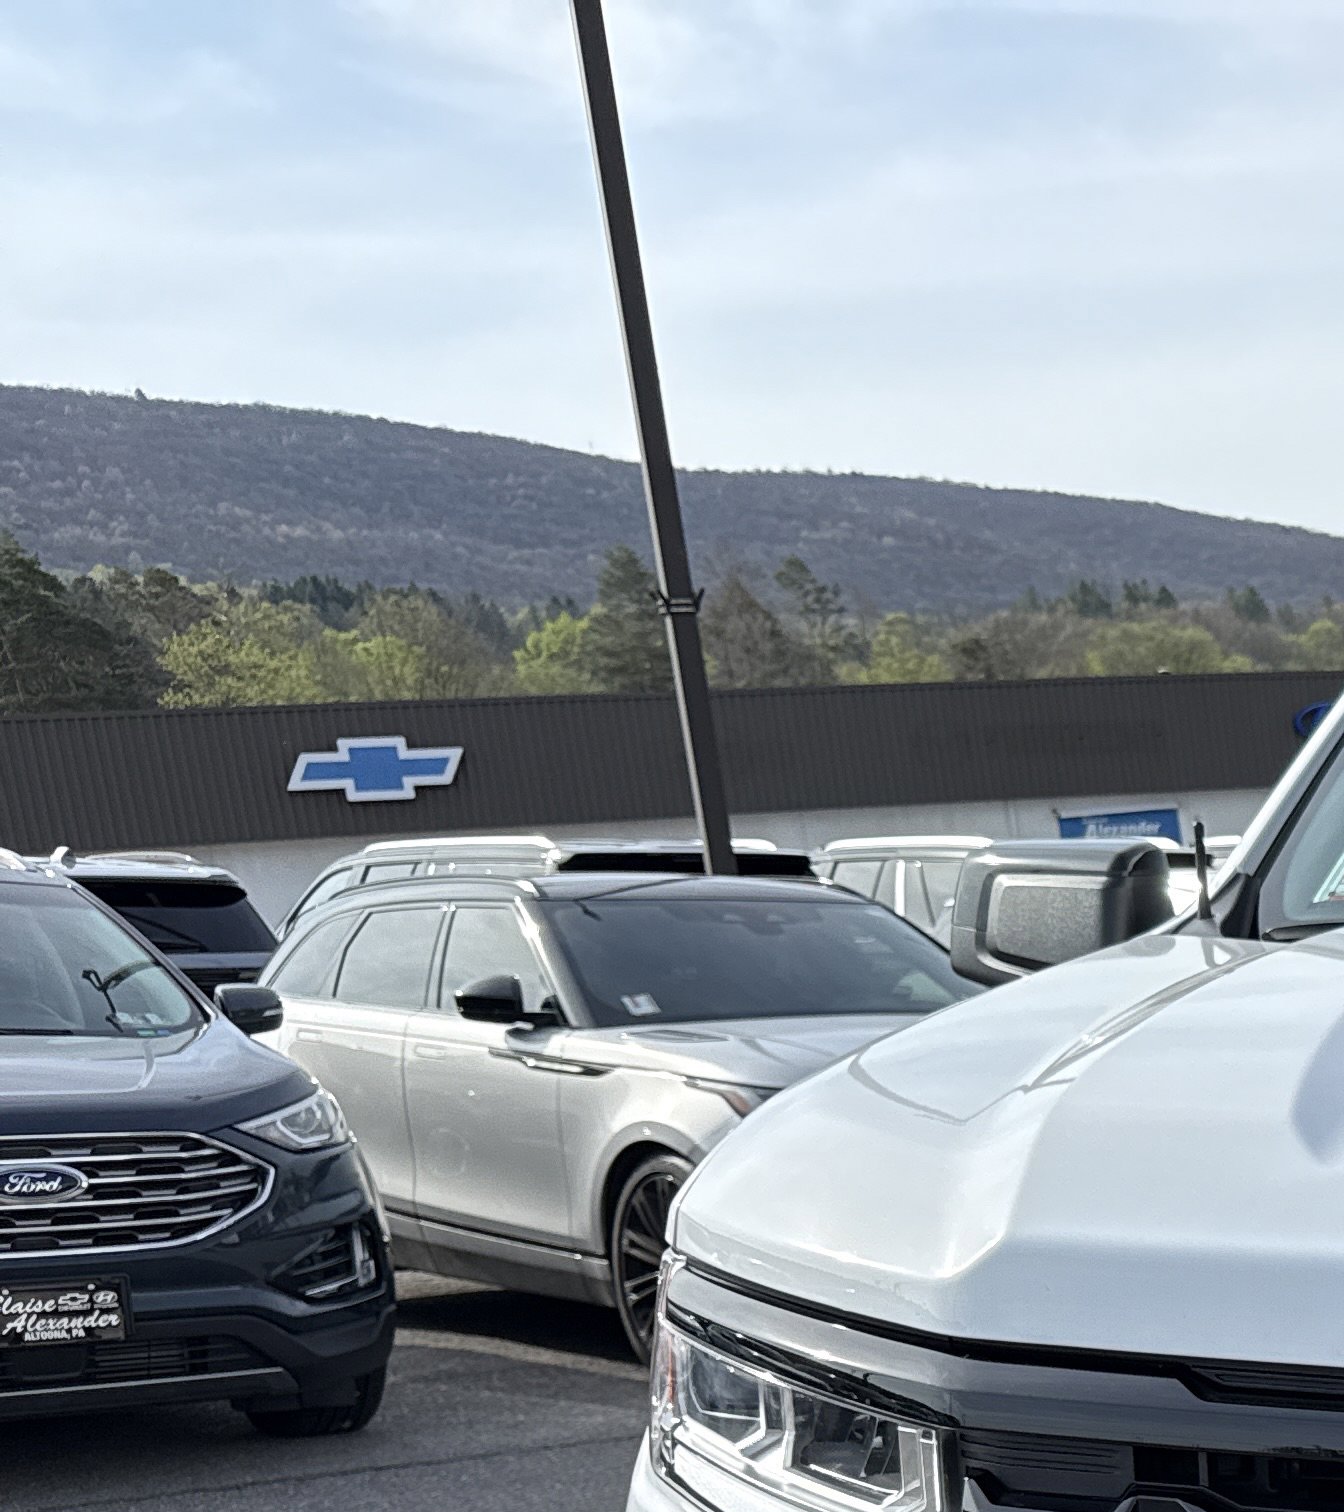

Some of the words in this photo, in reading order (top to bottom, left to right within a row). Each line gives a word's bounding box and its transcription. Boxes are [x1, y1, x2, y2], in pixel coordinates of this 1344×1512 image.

[4, 1172, 63, 1194] Ford
[0, 1294, 58, 1315] laise
[1, 1309, 121, 1336] Alexander
[71, 1327, 86, 1338] PA
